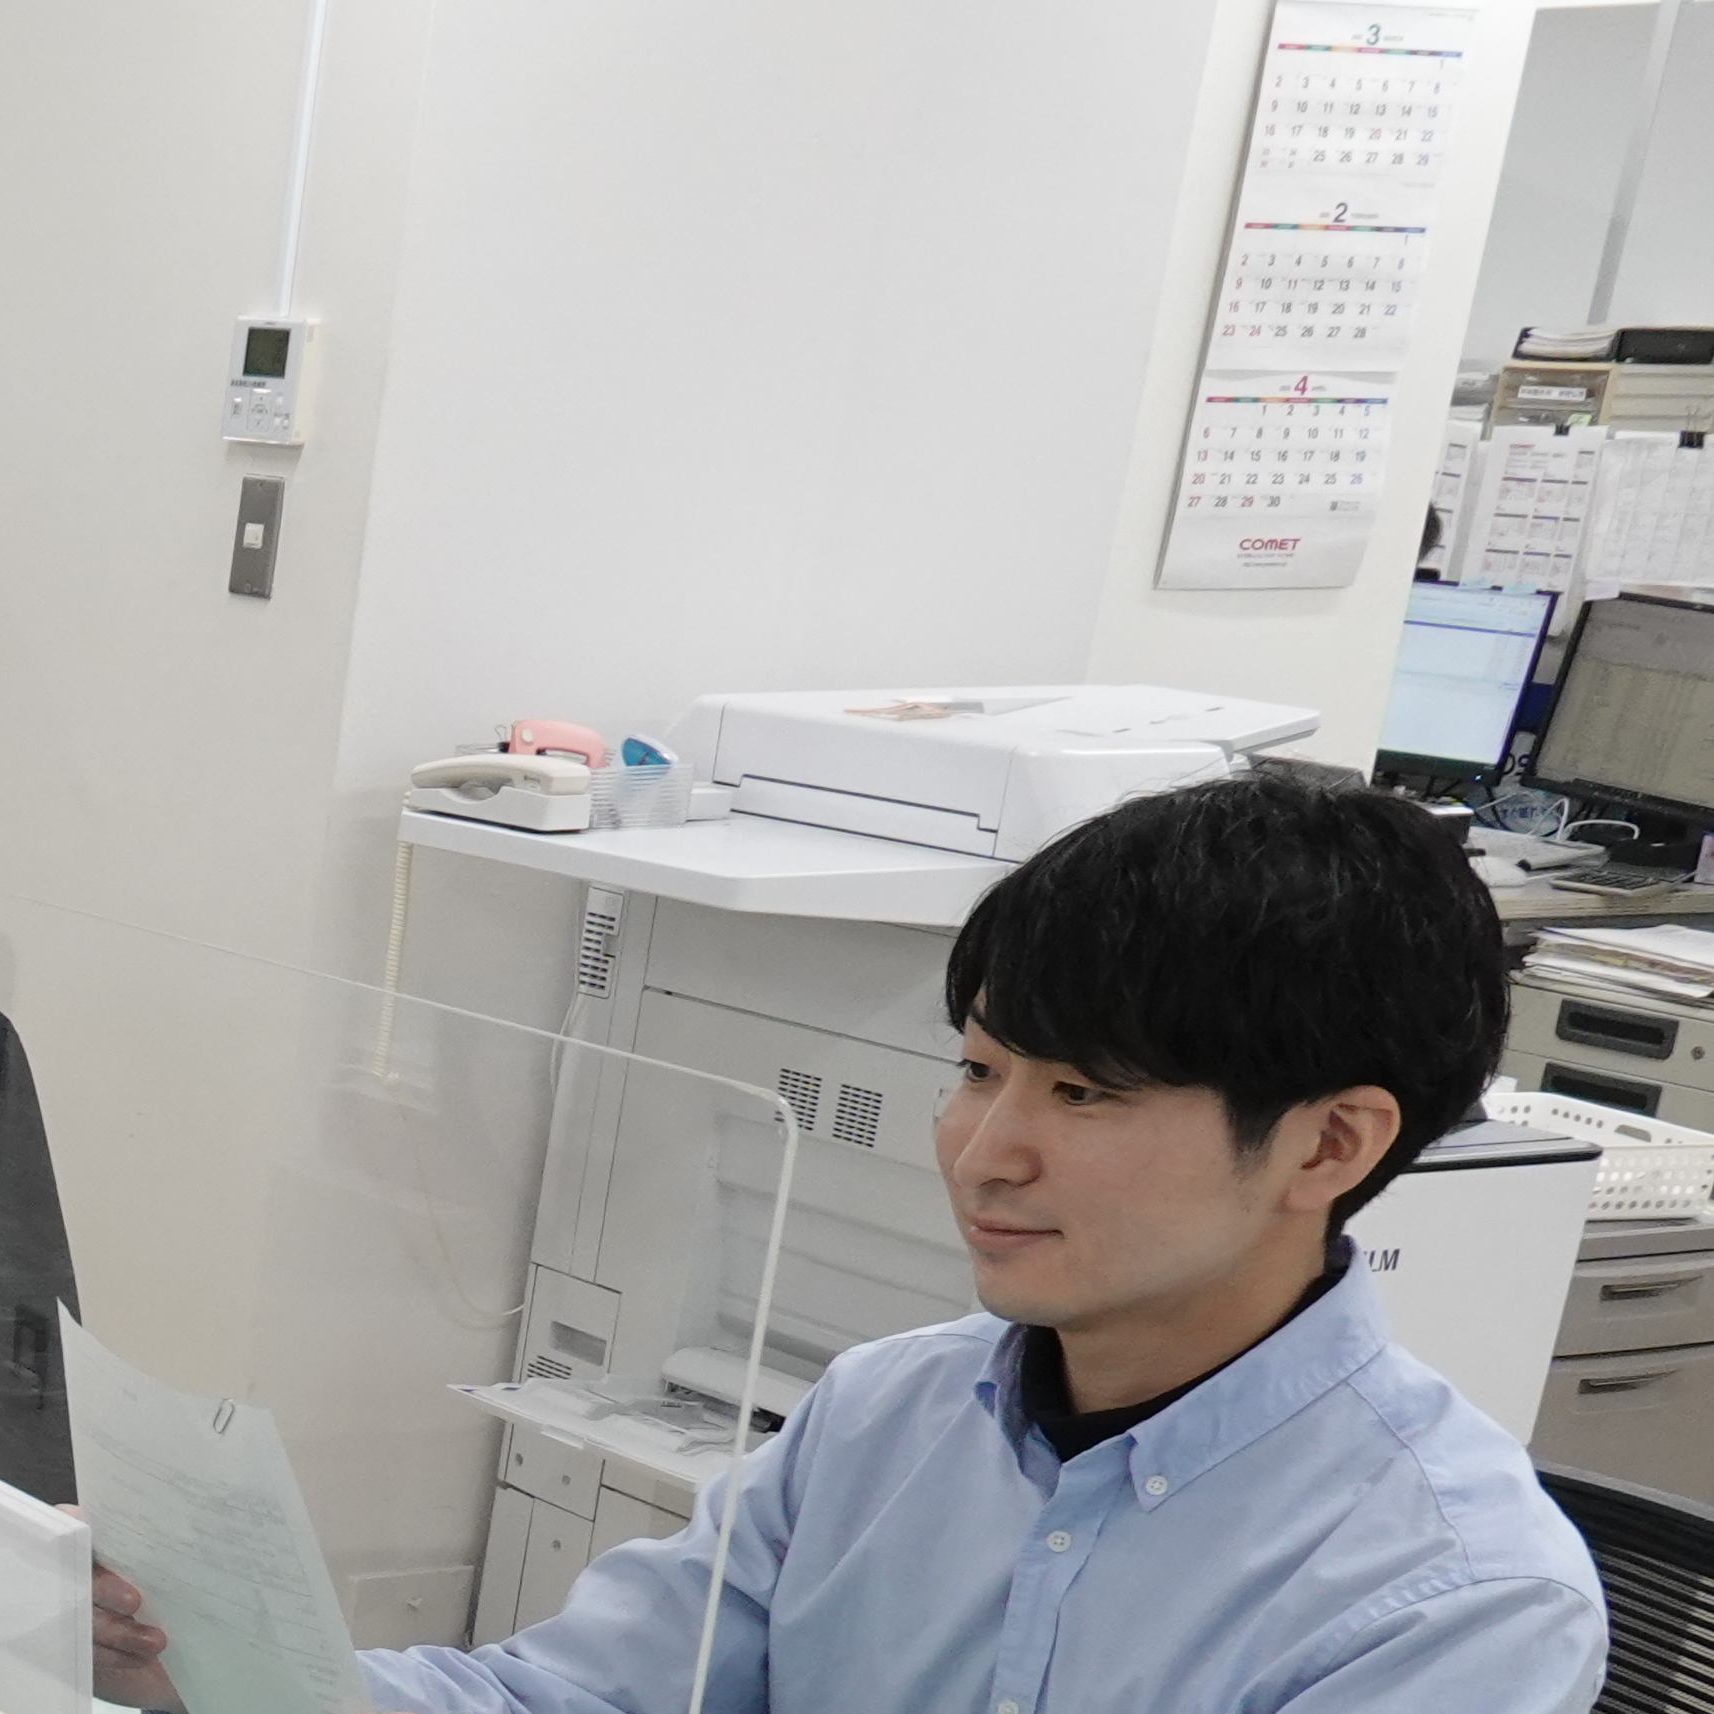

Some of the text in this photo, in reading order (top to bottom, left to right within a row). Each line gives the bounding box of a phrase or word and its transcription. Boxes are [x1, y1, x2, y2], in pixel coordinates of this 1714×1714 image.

[1366, 24, 1381, 45] 3
[1334, 203, 1348, 223] 2
[1294, 376, 1308, 395] 4
[1239, 538, 1300, 551] COMET
[1364, 1248, 1401, 1272] LM
